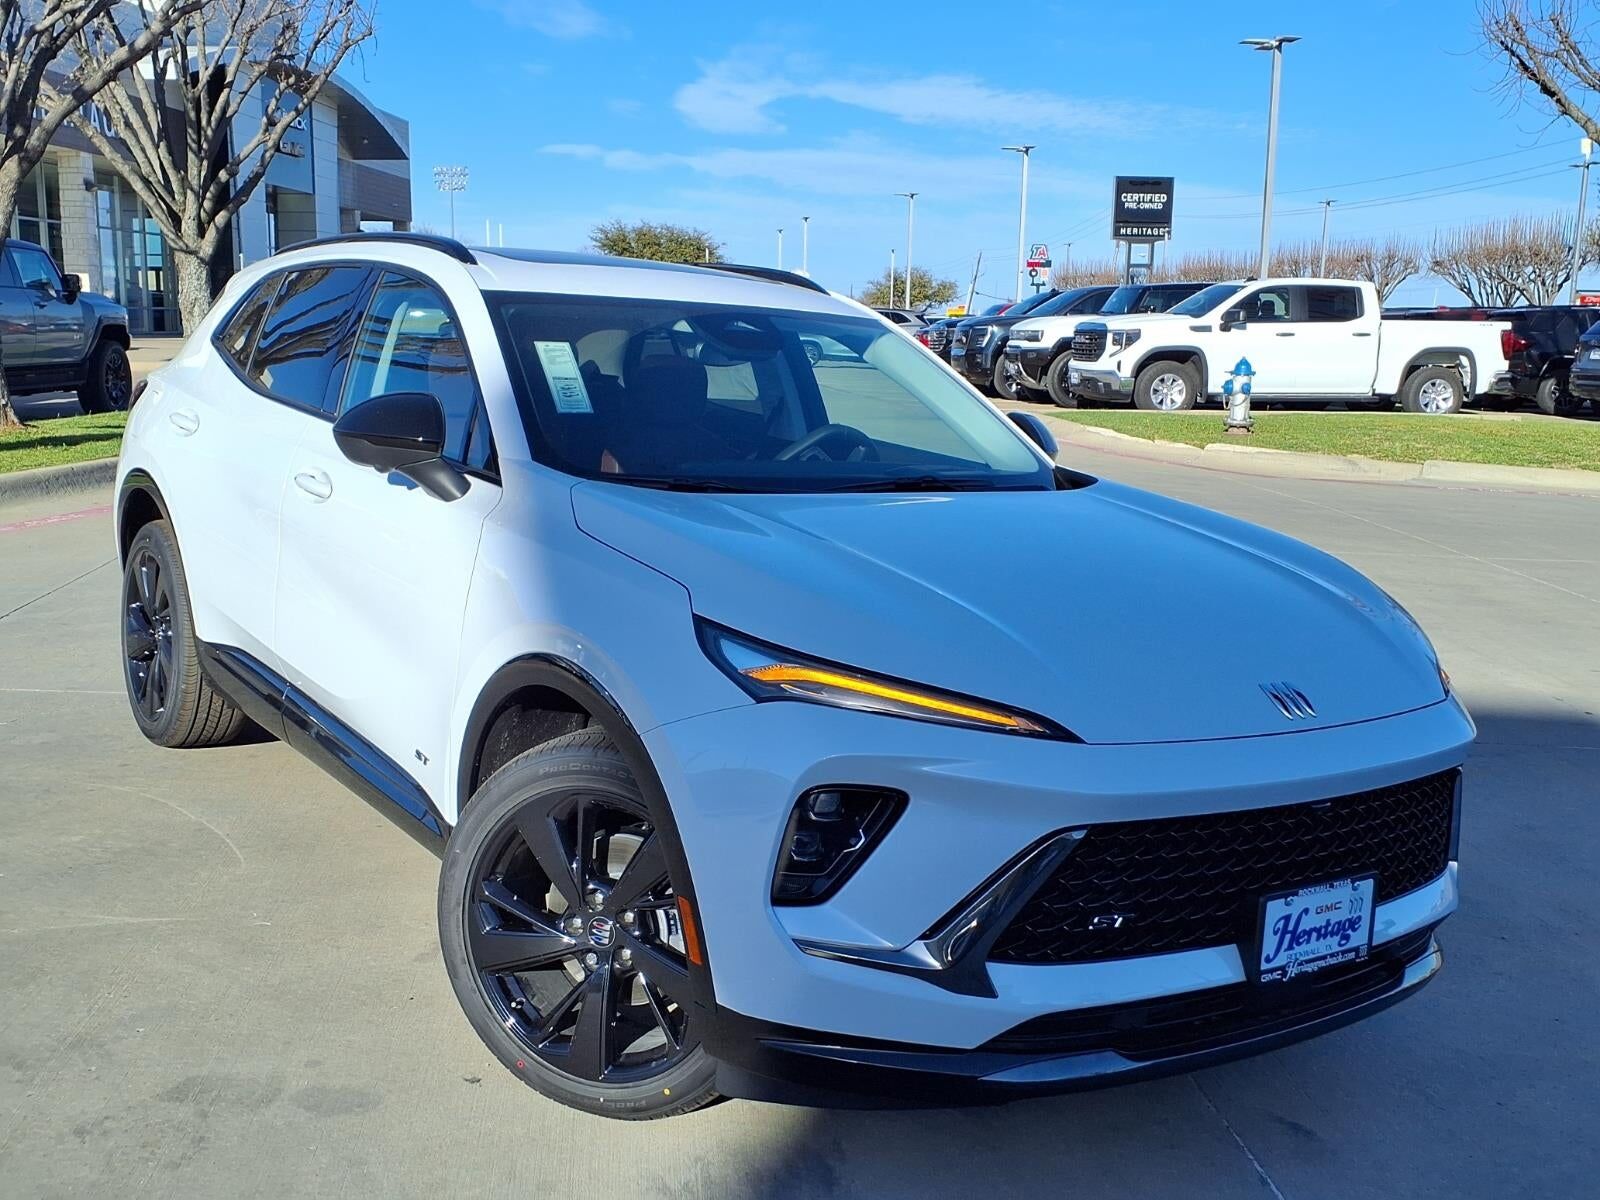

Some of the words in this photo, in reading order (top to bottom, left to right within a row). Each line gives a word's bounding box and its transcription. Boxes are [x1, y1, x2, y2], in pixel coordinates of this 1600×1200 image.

[1121, 193, 1168, 203] CERTIFIED
[1124, 202, 1164, 210] PRE-OWNED
[414, 749, 430, 766] ST
[1315, 901, 1343, 915] GMC
[1264, 907, 1362, 964] Heritage
[1261, 970, 1283, 982] GMC
